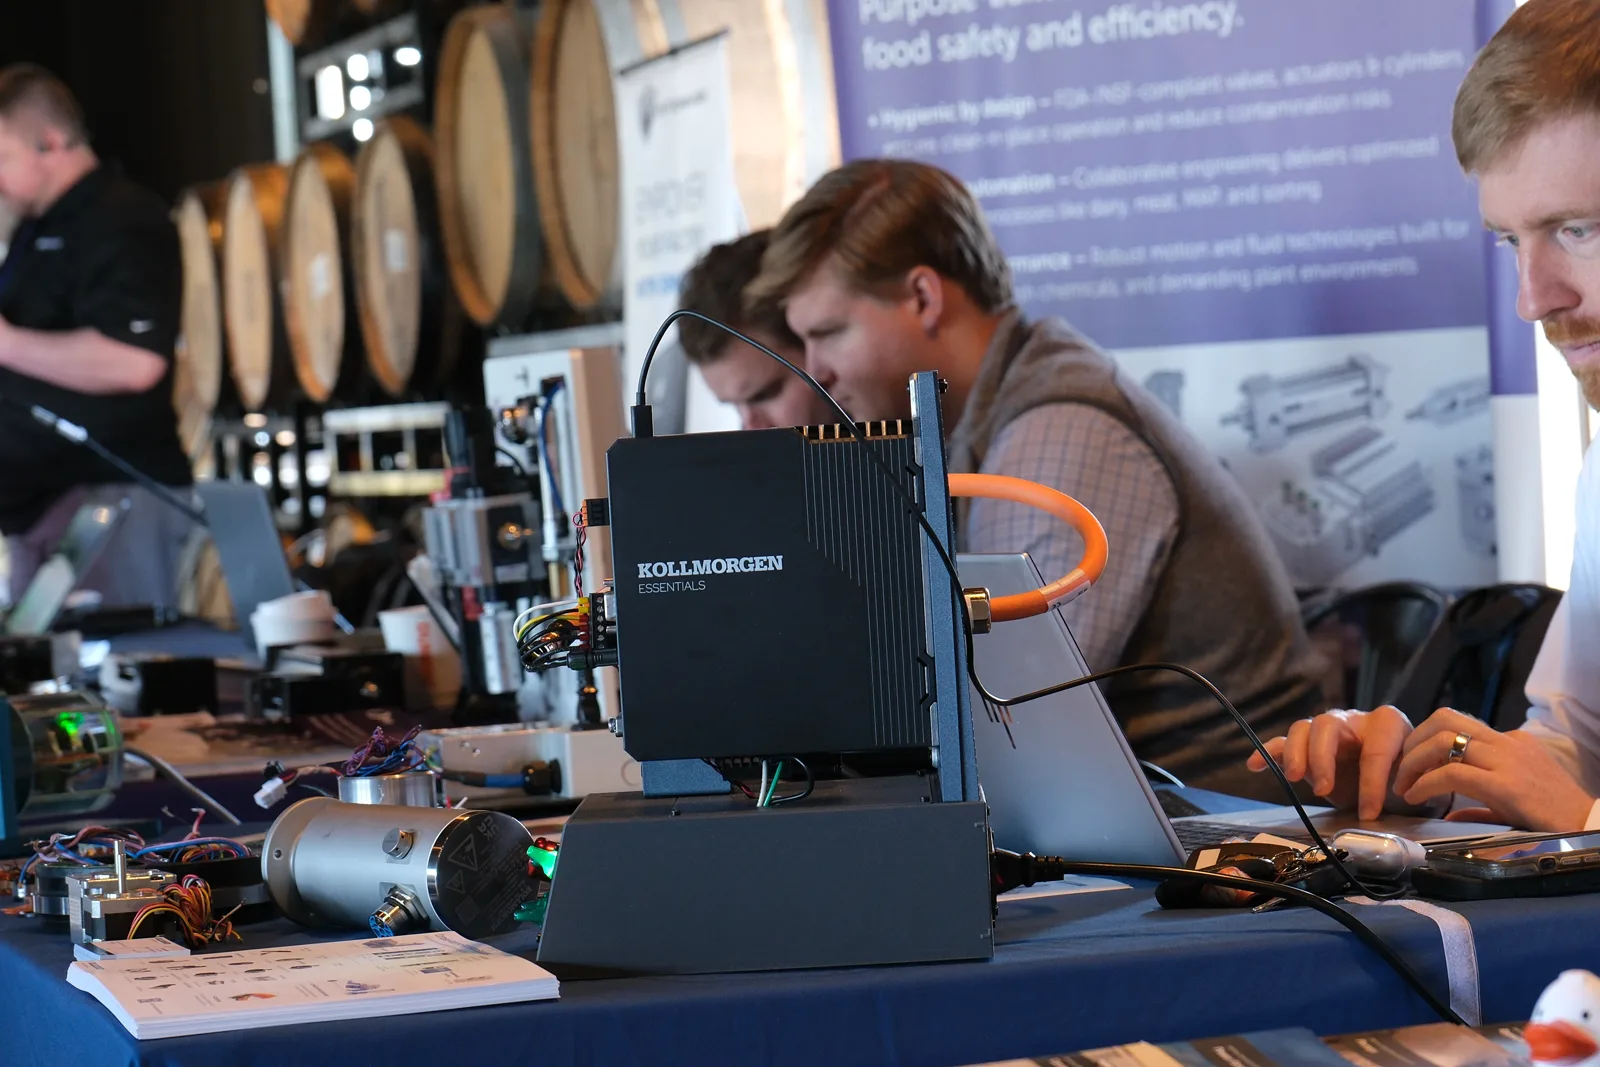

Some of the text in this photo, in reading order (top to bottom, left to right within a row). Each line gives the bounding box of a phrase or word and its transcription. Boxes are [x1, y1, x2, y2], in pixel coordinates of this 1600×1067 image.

[862, 2, 1245, 70] food safety and efficiency.
[878, 104, 956, 132] Hygienic
[958, 100, 980, 125] by
[983, 95, 1038, 120] design
[1283, 60, 1364, 86] actuators
[1053, 116, 1128, 142] operation
[1133, 111, 1163, 133] and
[1167, 106, 1224, 130] reduce
[1226, 94, 1346, 125] contamination
[1072, 160, 1178, 190] Collaborative
[1180, 152, 1280, 181] engineering
[1283, 146, 1348, 171] delivers
[1352, 135, 1439, 164] optimized
[1227, 184, 1259, 206] and
[1262, 179, 1322, 204] sorting
[1090, 245, 1147, 268] Robust
[1150, 242, 1209, 264] motion
[1212, 237, 1245, 259] and
[1246, 233, 1284, 256] fluid
[1285, 225, 1397, 254] technologies
[1400, 220, 1440, 243] built
[1442, 216, 1470, 240] for
[1124, 274, 1155, 297] and
[1157, 267, 1250, 295] demanding
[1253, 263, 1297, 288] plant
[637, 555, 783, 578] KOLLMORGEN
[638, 580, 706, 594] ESSENTIALS
